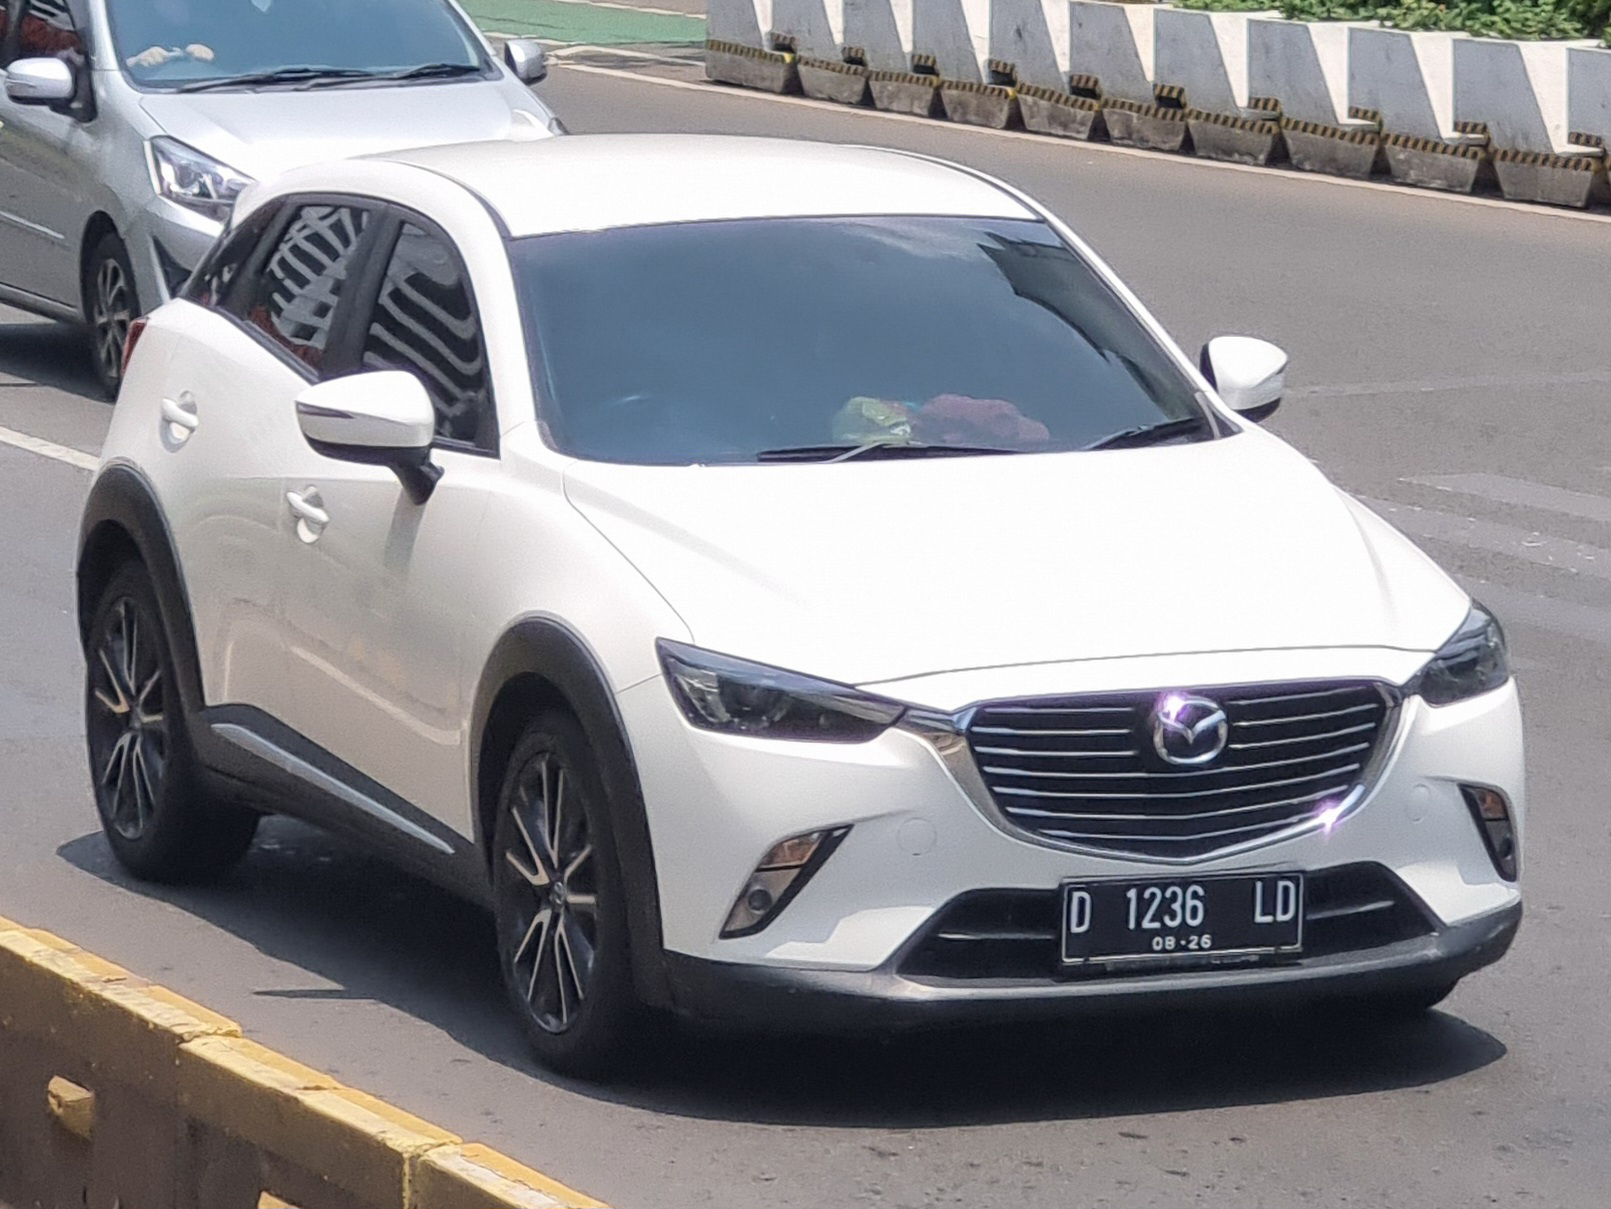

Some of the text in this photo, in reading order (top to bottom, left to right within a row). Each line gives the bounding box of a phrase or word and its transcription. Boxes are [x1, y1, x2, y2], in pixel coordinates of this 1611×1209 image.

[1070, 880, 1296, 933] D 1236 LD
